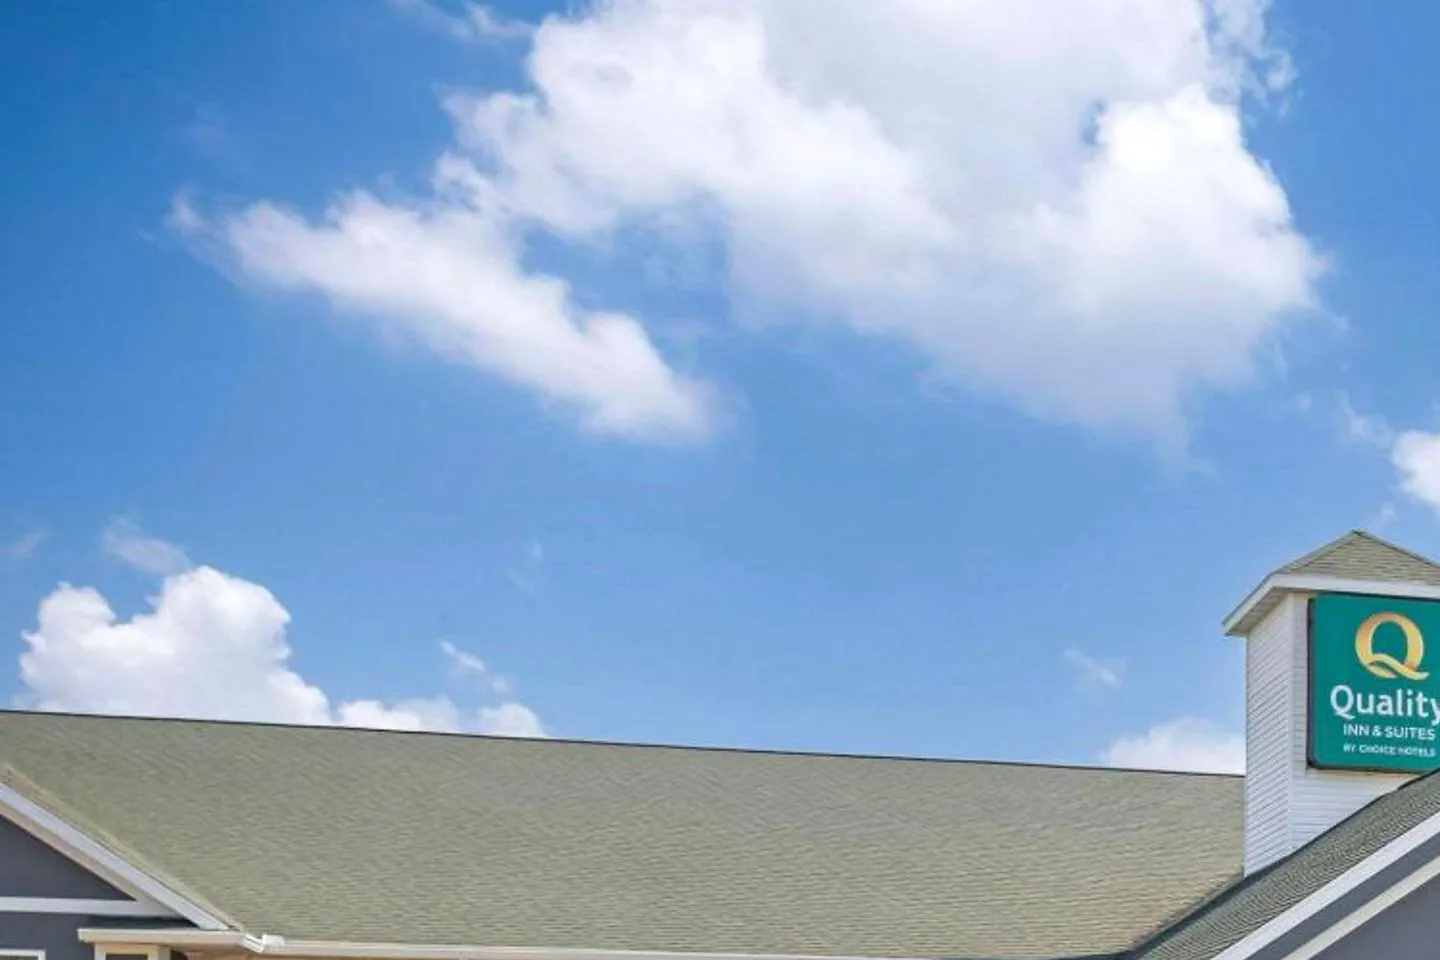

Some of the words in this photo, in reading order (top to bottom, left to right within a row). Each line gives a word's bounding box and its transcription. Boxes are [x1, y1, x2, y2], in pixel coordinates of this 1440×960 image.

[1355, 611, 1430, 681] Q
[1343, 723, 1370, 736] INN
[1372, 725, 1382, 737] &
[1385, 726, 1436, 740] SUITES
[1359, 744, 1397, 756] CHOICE
